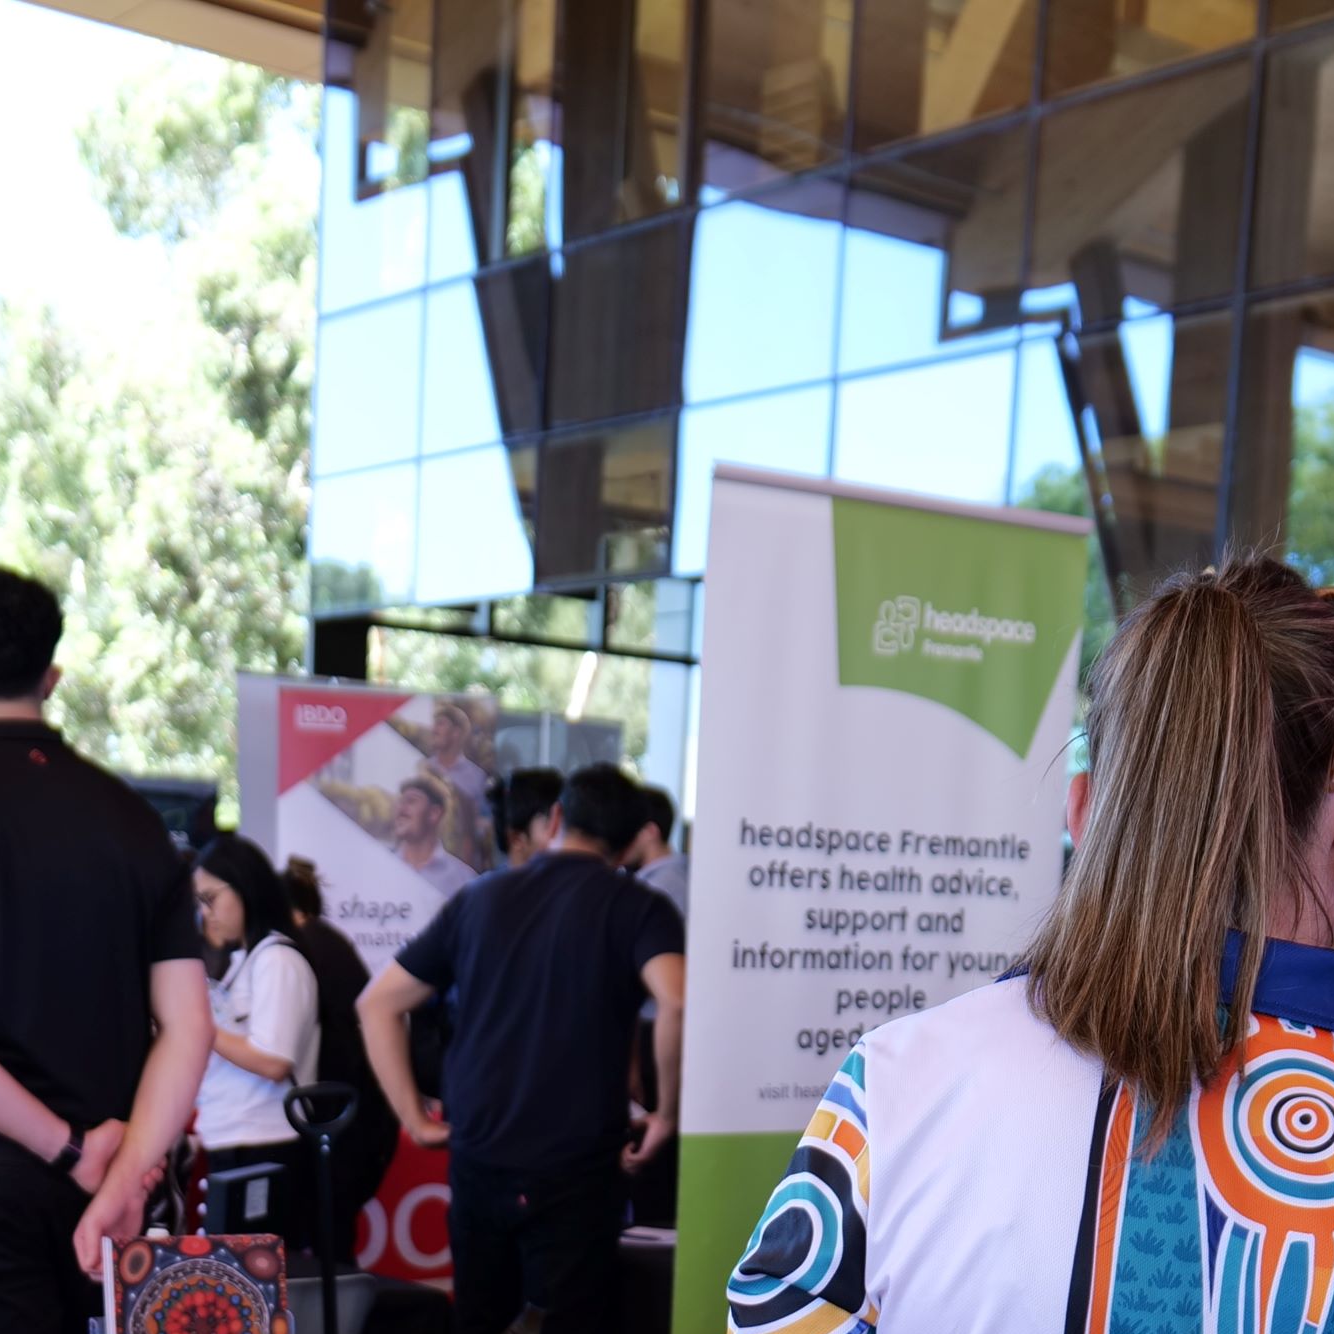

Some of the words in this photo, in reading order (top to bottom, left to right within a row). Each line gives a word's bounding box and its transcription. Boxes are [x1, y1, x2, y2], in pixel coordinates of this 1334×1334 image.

[924, 602, 1036, 643] headspace
[299, 705, 347, 725] BDO
[739, 817, 892, 857] headspace
[900, 830, 1032, 861] Fremantle
[749, 859, 832, 890] offers
[839, 863, 923, 893] health
[931, 869, 1020, 901] advice,
[338, 894, 412, 926] shape
[805, 906, 909, 936] support
[917, 909, 965, 933] and
[732, 940, 893, 971] information
[901, 945, 939, 971] for
[836, 984, 927, 1015] people
[797, 1023, 864, 1055] aged
[758, 1082, 790, 1100] visit
